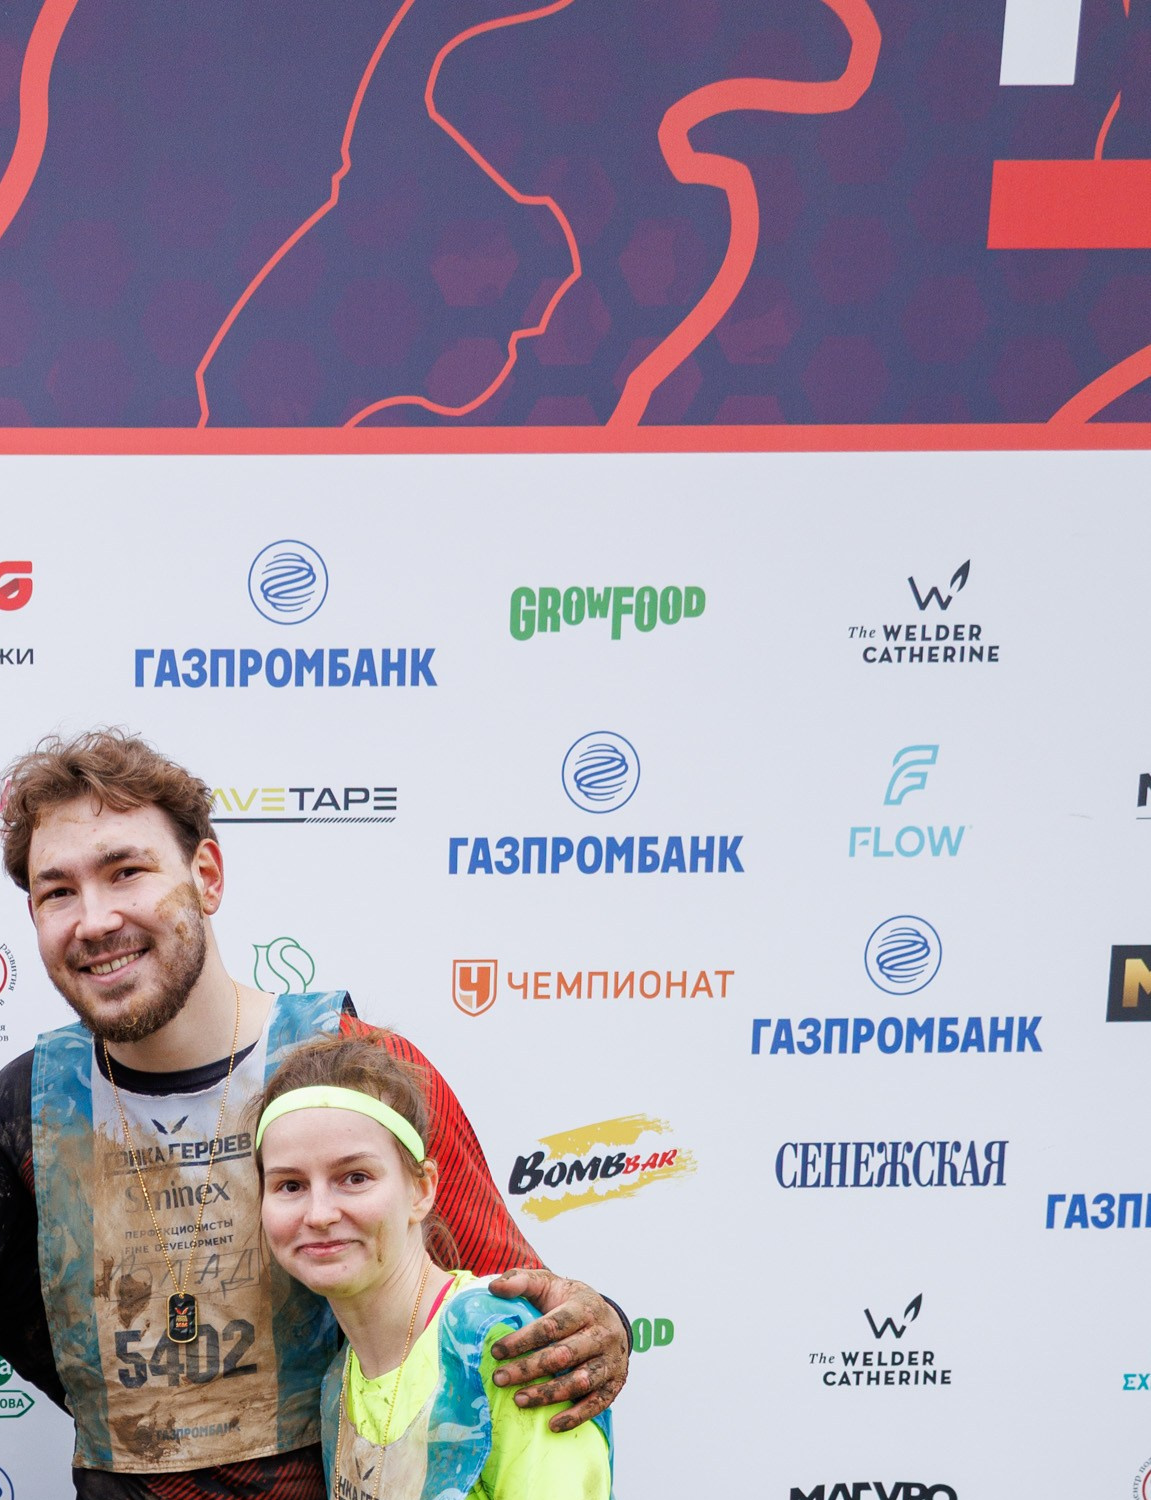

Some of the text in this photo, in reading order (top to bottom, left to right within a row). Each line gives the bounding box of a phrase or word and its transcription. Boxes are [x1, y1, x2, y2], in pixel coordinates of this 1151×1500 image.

[510, 585, 706, 641] GROWFOOD
[848, 624, 982, 641] The WELDER
[135, 648, 438, 688] ГАЗПРОМБАНК
[863, 645, 1000, 663] CATHERINE
[449, 835, 744, 875] ГАЗПРОМБАНК
[849, 826, 965, 858] FLOW
[507, 970, 735, 1000] ЧЕМПИОНАТ
[751, 1016, 1043, 1055] ГАЗПРОМБАНК
[168, 1132, 252, 1160] ГЕРОЕВ
[775, 1140, 1009, 1189] СЕНЕЖСКАЯ
[125, 1180, 231, 1213] Sminex
[125, 1235, 234, 1255] FINE DEVELOPMENT
[115, 1319, 257, 1389] 5402
[809, 1351, 935, 1366] The WELDER
[823, 1369, 952, 1386] CATHERINE
